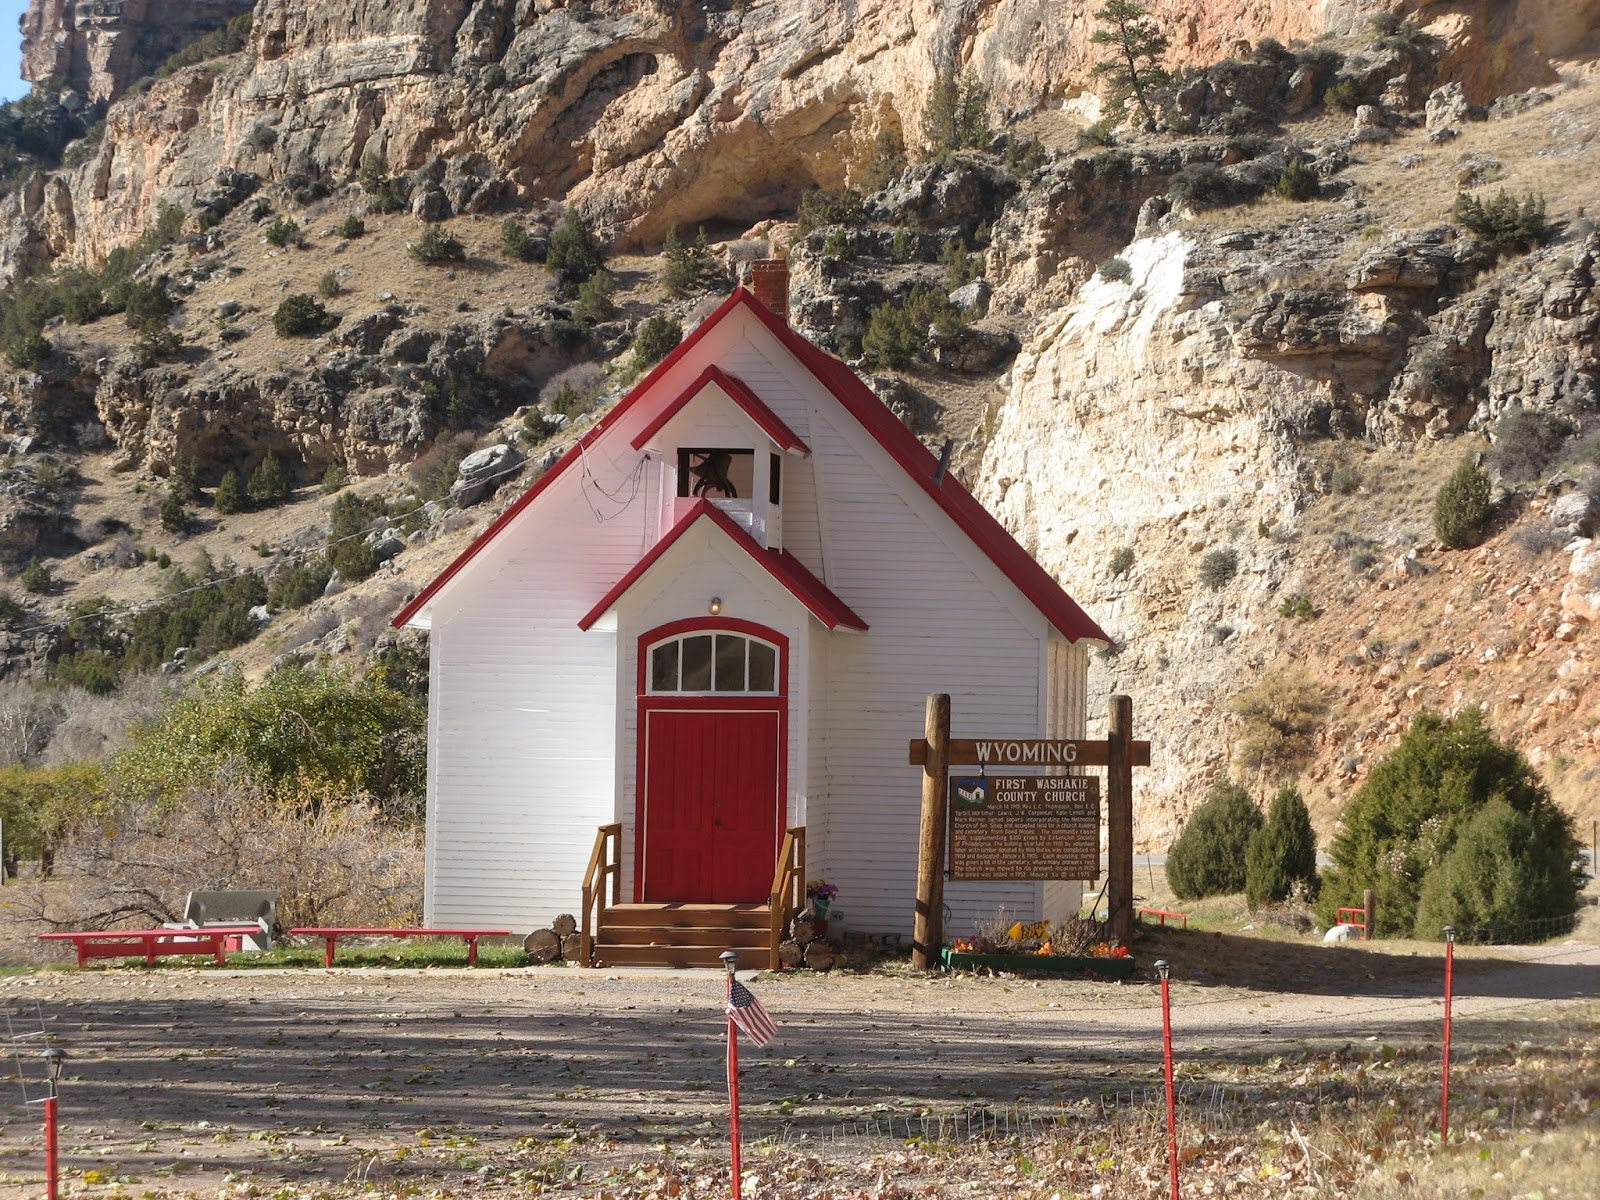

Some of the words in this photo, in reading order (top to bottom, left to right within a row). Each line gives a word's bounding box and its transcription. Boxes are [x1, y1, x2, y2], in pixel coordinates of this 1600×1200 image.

[976, 742, 1076, 762] WYOMING
[995, 779, 1026, 790] FIRST
[1036, 779, 1088, 790] WASHAKIE
[996, 791, 1037, 802] COUNTY
[1044, 791, 1086, 802] CHURCH
